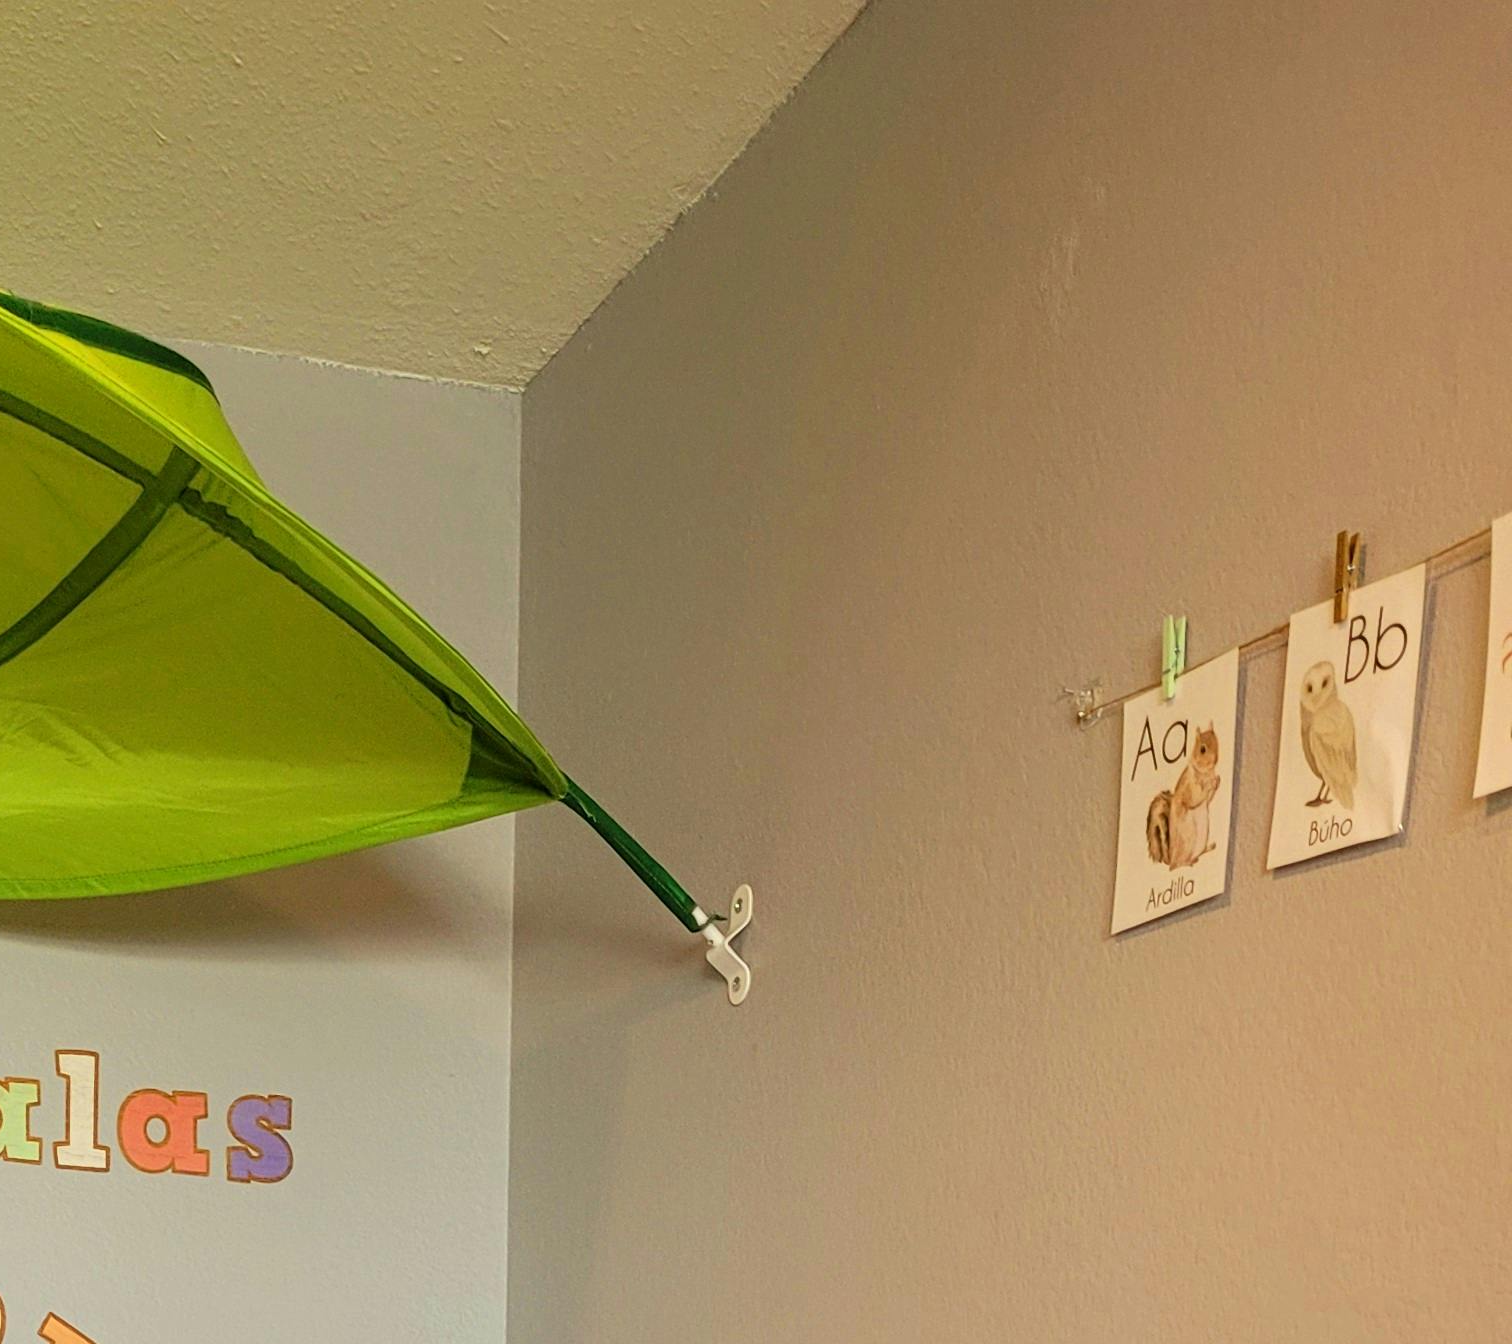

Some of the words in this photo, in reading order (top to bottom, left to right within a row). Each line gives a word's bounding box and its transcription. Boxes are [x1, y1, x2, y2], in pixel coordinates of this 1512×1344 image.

[1343, 606, 1408, 686] Bb
[1130, 715, 1189, 781] Aa
[1307, 815, 1353, 847] Búho
[1145, 876, 1195, 912] Ardilla
